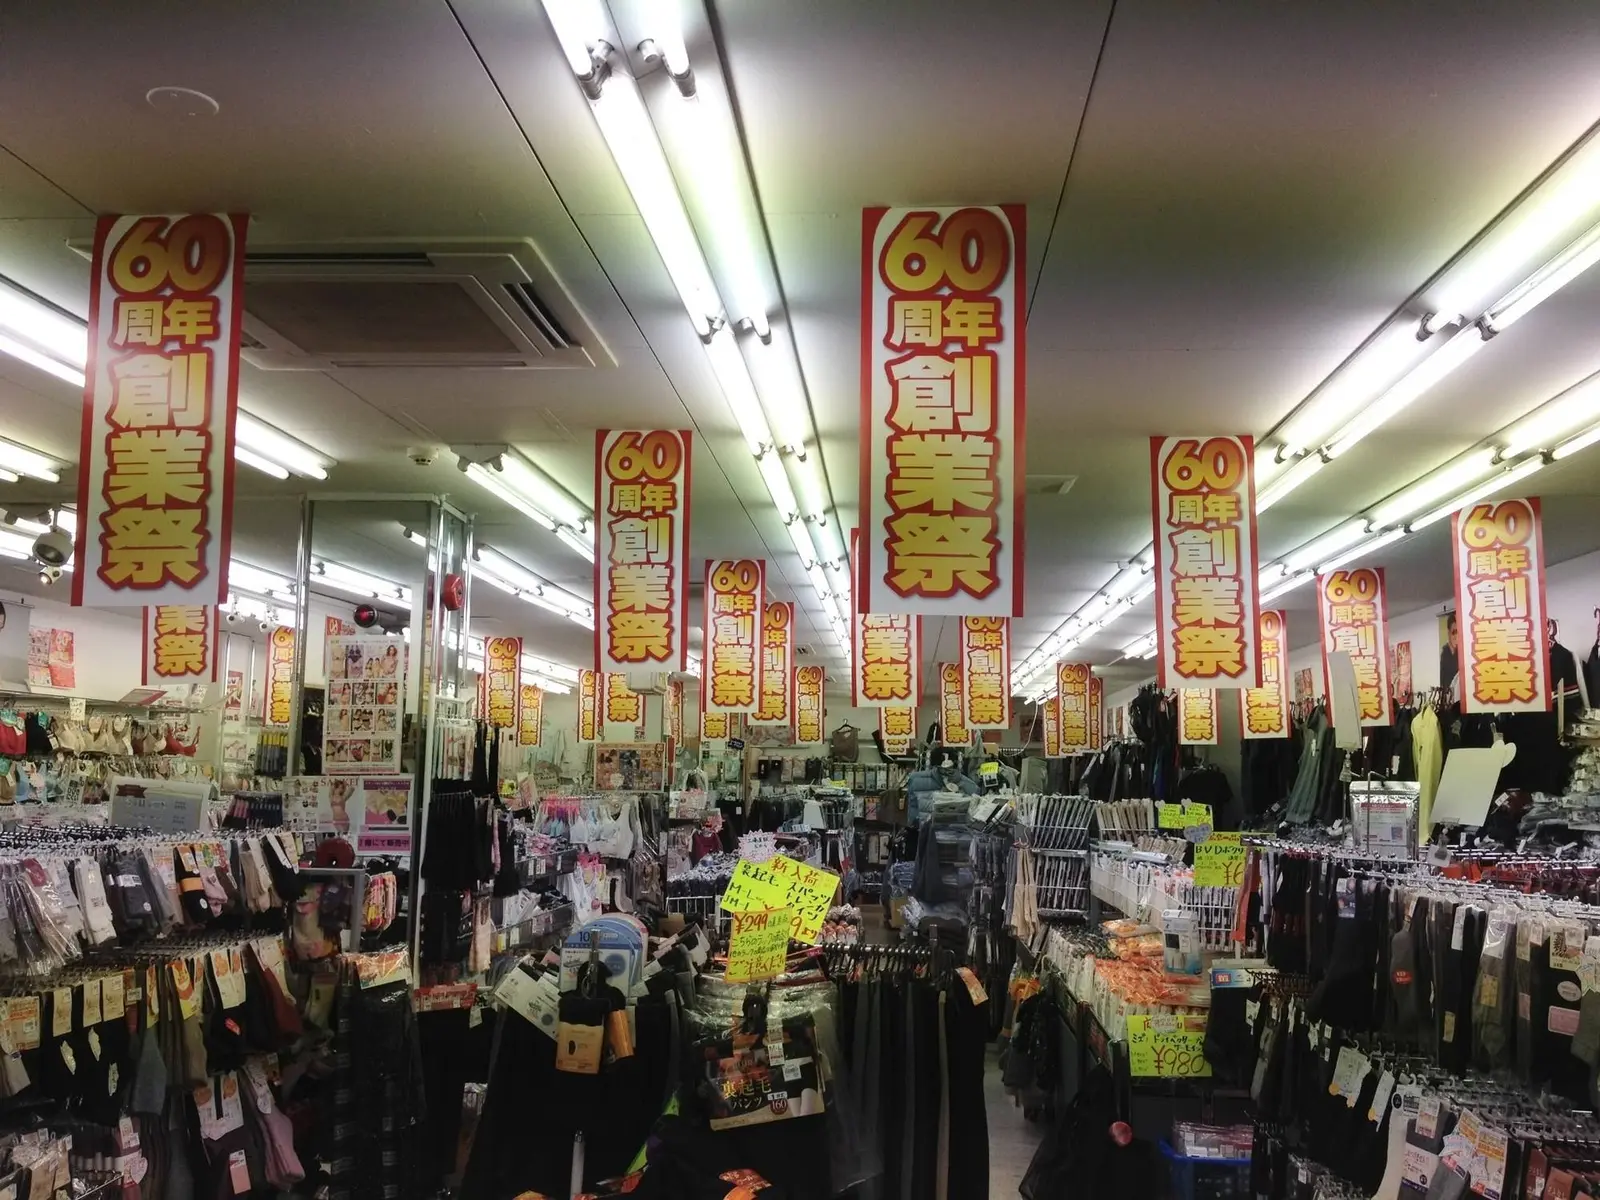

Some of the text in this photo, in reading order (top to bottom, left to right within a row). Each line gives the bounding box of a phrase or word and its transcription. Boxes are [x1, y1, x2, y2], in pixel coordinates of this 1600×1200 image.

[107, 213, 230, 297] 60
[879, 208, 1010, 294] 60
[110, 294, 219, 350] 周年
[883, 294, 1002, 352] 周年
[101, 348, 212, 588] 創業祭
[605, 430, 681, 481] 60
[1162, 437, 1244, 491] 60
[883, 351, 1002, 598] 創業祭
[608, 481, 676, 516] 周年
[1167, 491, 1240, 528] 周年
[1461, 500, 1532, 548] 60
[710, 559, 759, 594] 60
[1467, 546, 1530, 578] 周年
[607, 515, 674, 663] 創業祭
[713, 592, 756, 614] 周年
[1168, 526, 1247, 679] 創業祭
[1325, 569, 1377, 603] 60
[1329, 602, 1376, 625] 周年
[488, 637, 519, 659] 60
[1468, 576, 1537, 704] 創業祭
[711, 613, 754, 706] 創業祭
[796, 666, 822, 685] 60
[1061, 664, 1087, 684] 60
[967, 648, 1004, 724] 創業祭
[770, 857, 819, 886] 新入荷
[785, 892, 825, 912] トレンカ
[786, 882, 831, 903] スパッツ
[734, 912, 769, 935] ¥299
[1151, 1045, 1205, 1075] ¥980
[722, 1076, 773, 1100] 裏起毛
